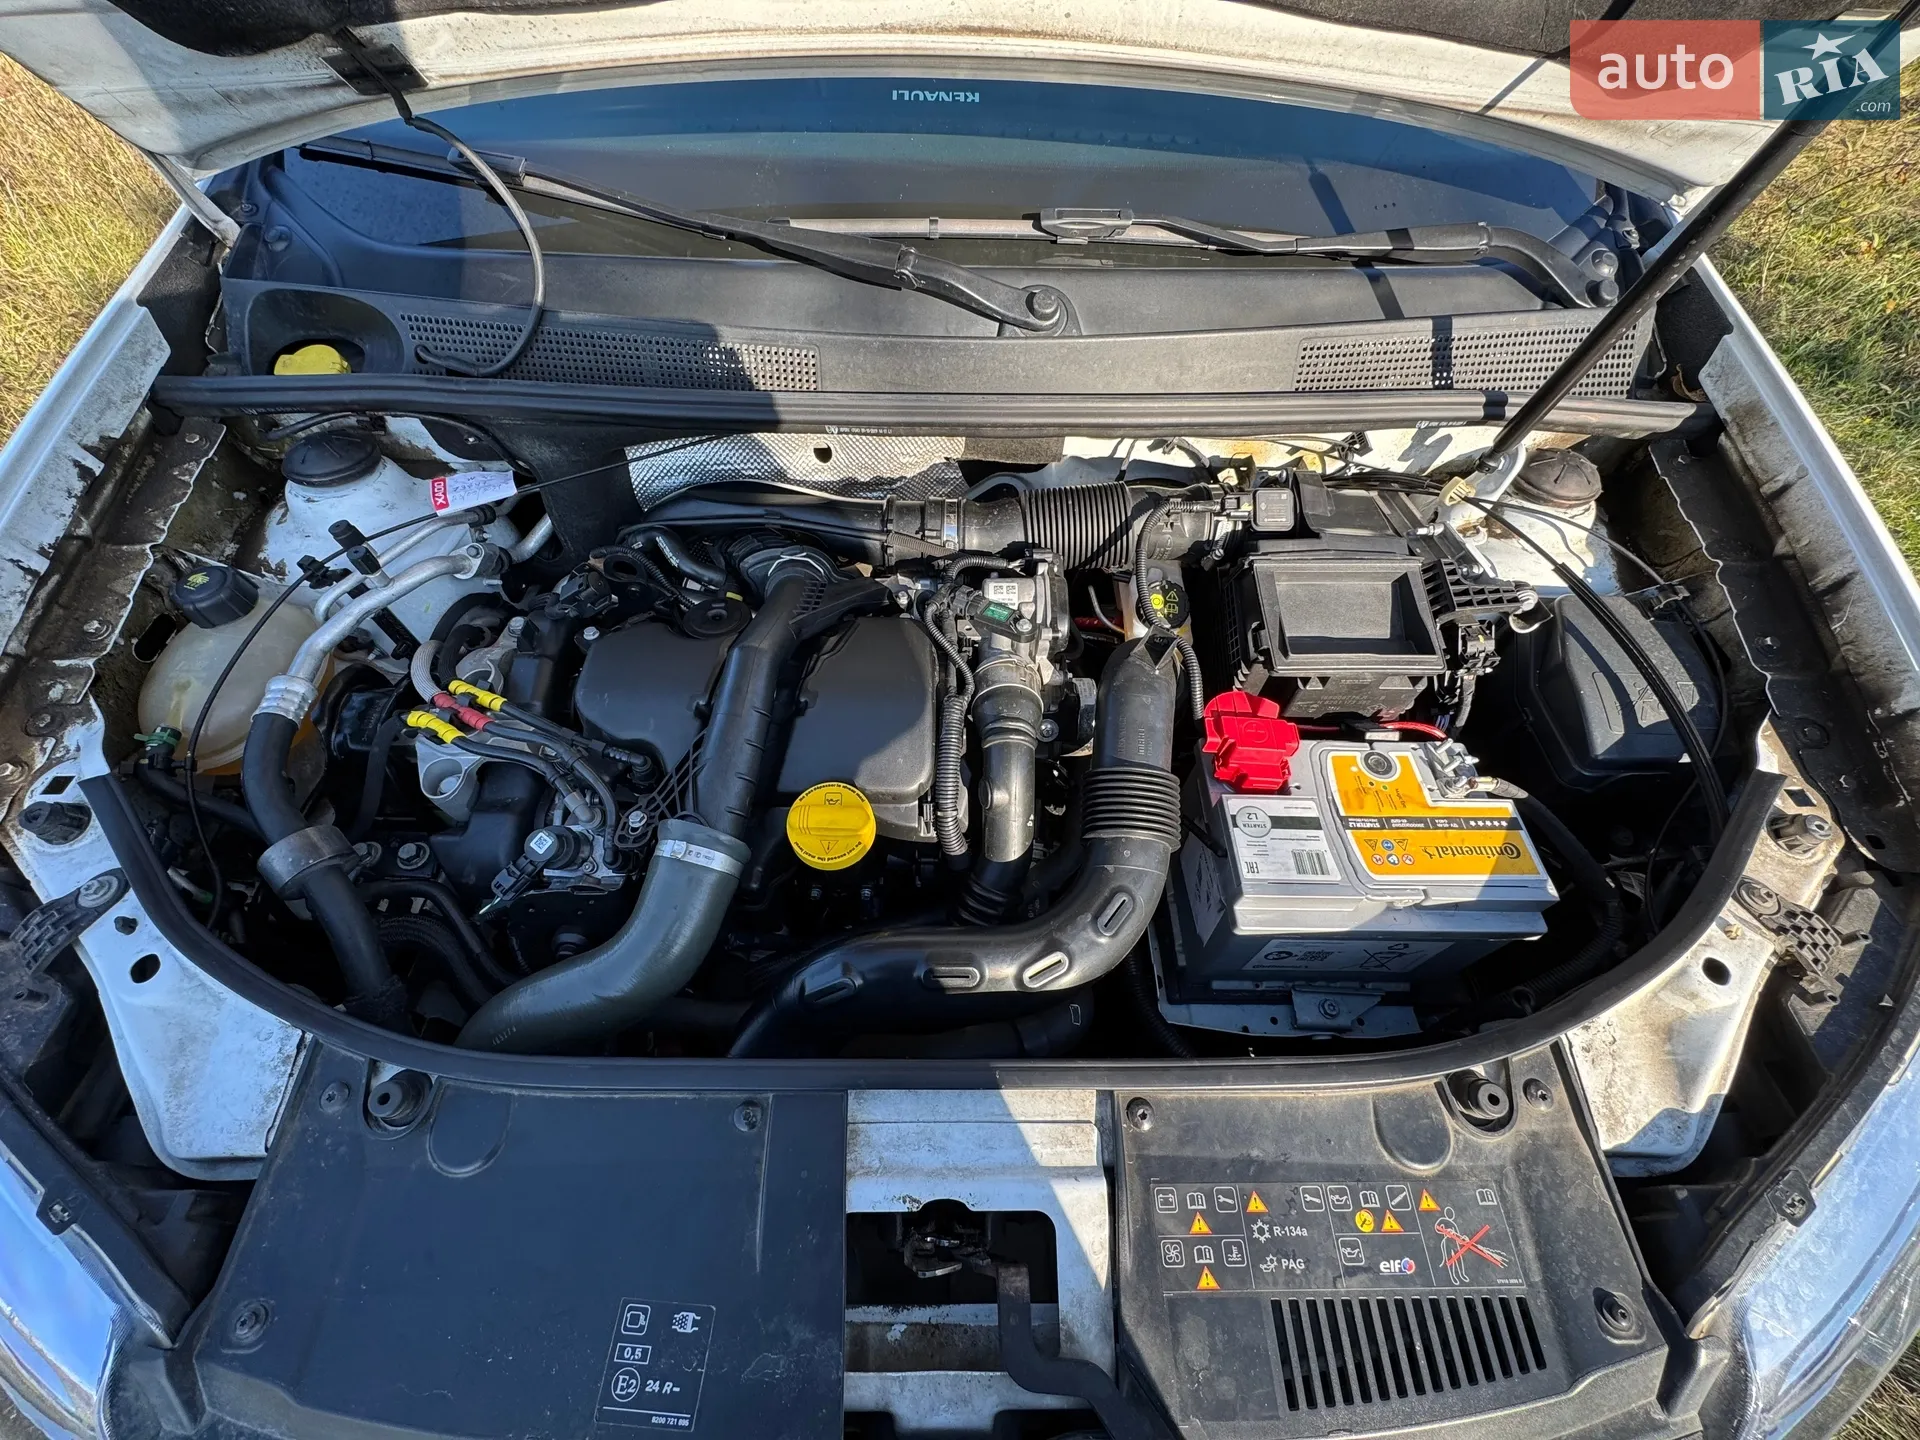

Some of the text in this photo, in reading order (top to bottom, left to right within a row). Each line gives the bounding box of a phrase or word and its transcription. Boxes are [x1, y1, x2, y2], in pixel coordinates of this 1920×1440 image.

[434, 481, 447, 506] XADO
[1246, 812, 1258, 820] L2
[1434, 842, 1521, 860] Continental
[1244, 861, 1259, 874] EAC
[1273, 1226, 1308, 1237] R-134a
[1281, 1258, 1305, 1270] PAG
[1379, 1258, 1402, 1273] elf
[624, 1347, 643, 1360] 0,5
[615, 1375, 637, 1395] E2
[645, 1380, 660, 1393] 24
[667, 1417, 678, 1425] 721
